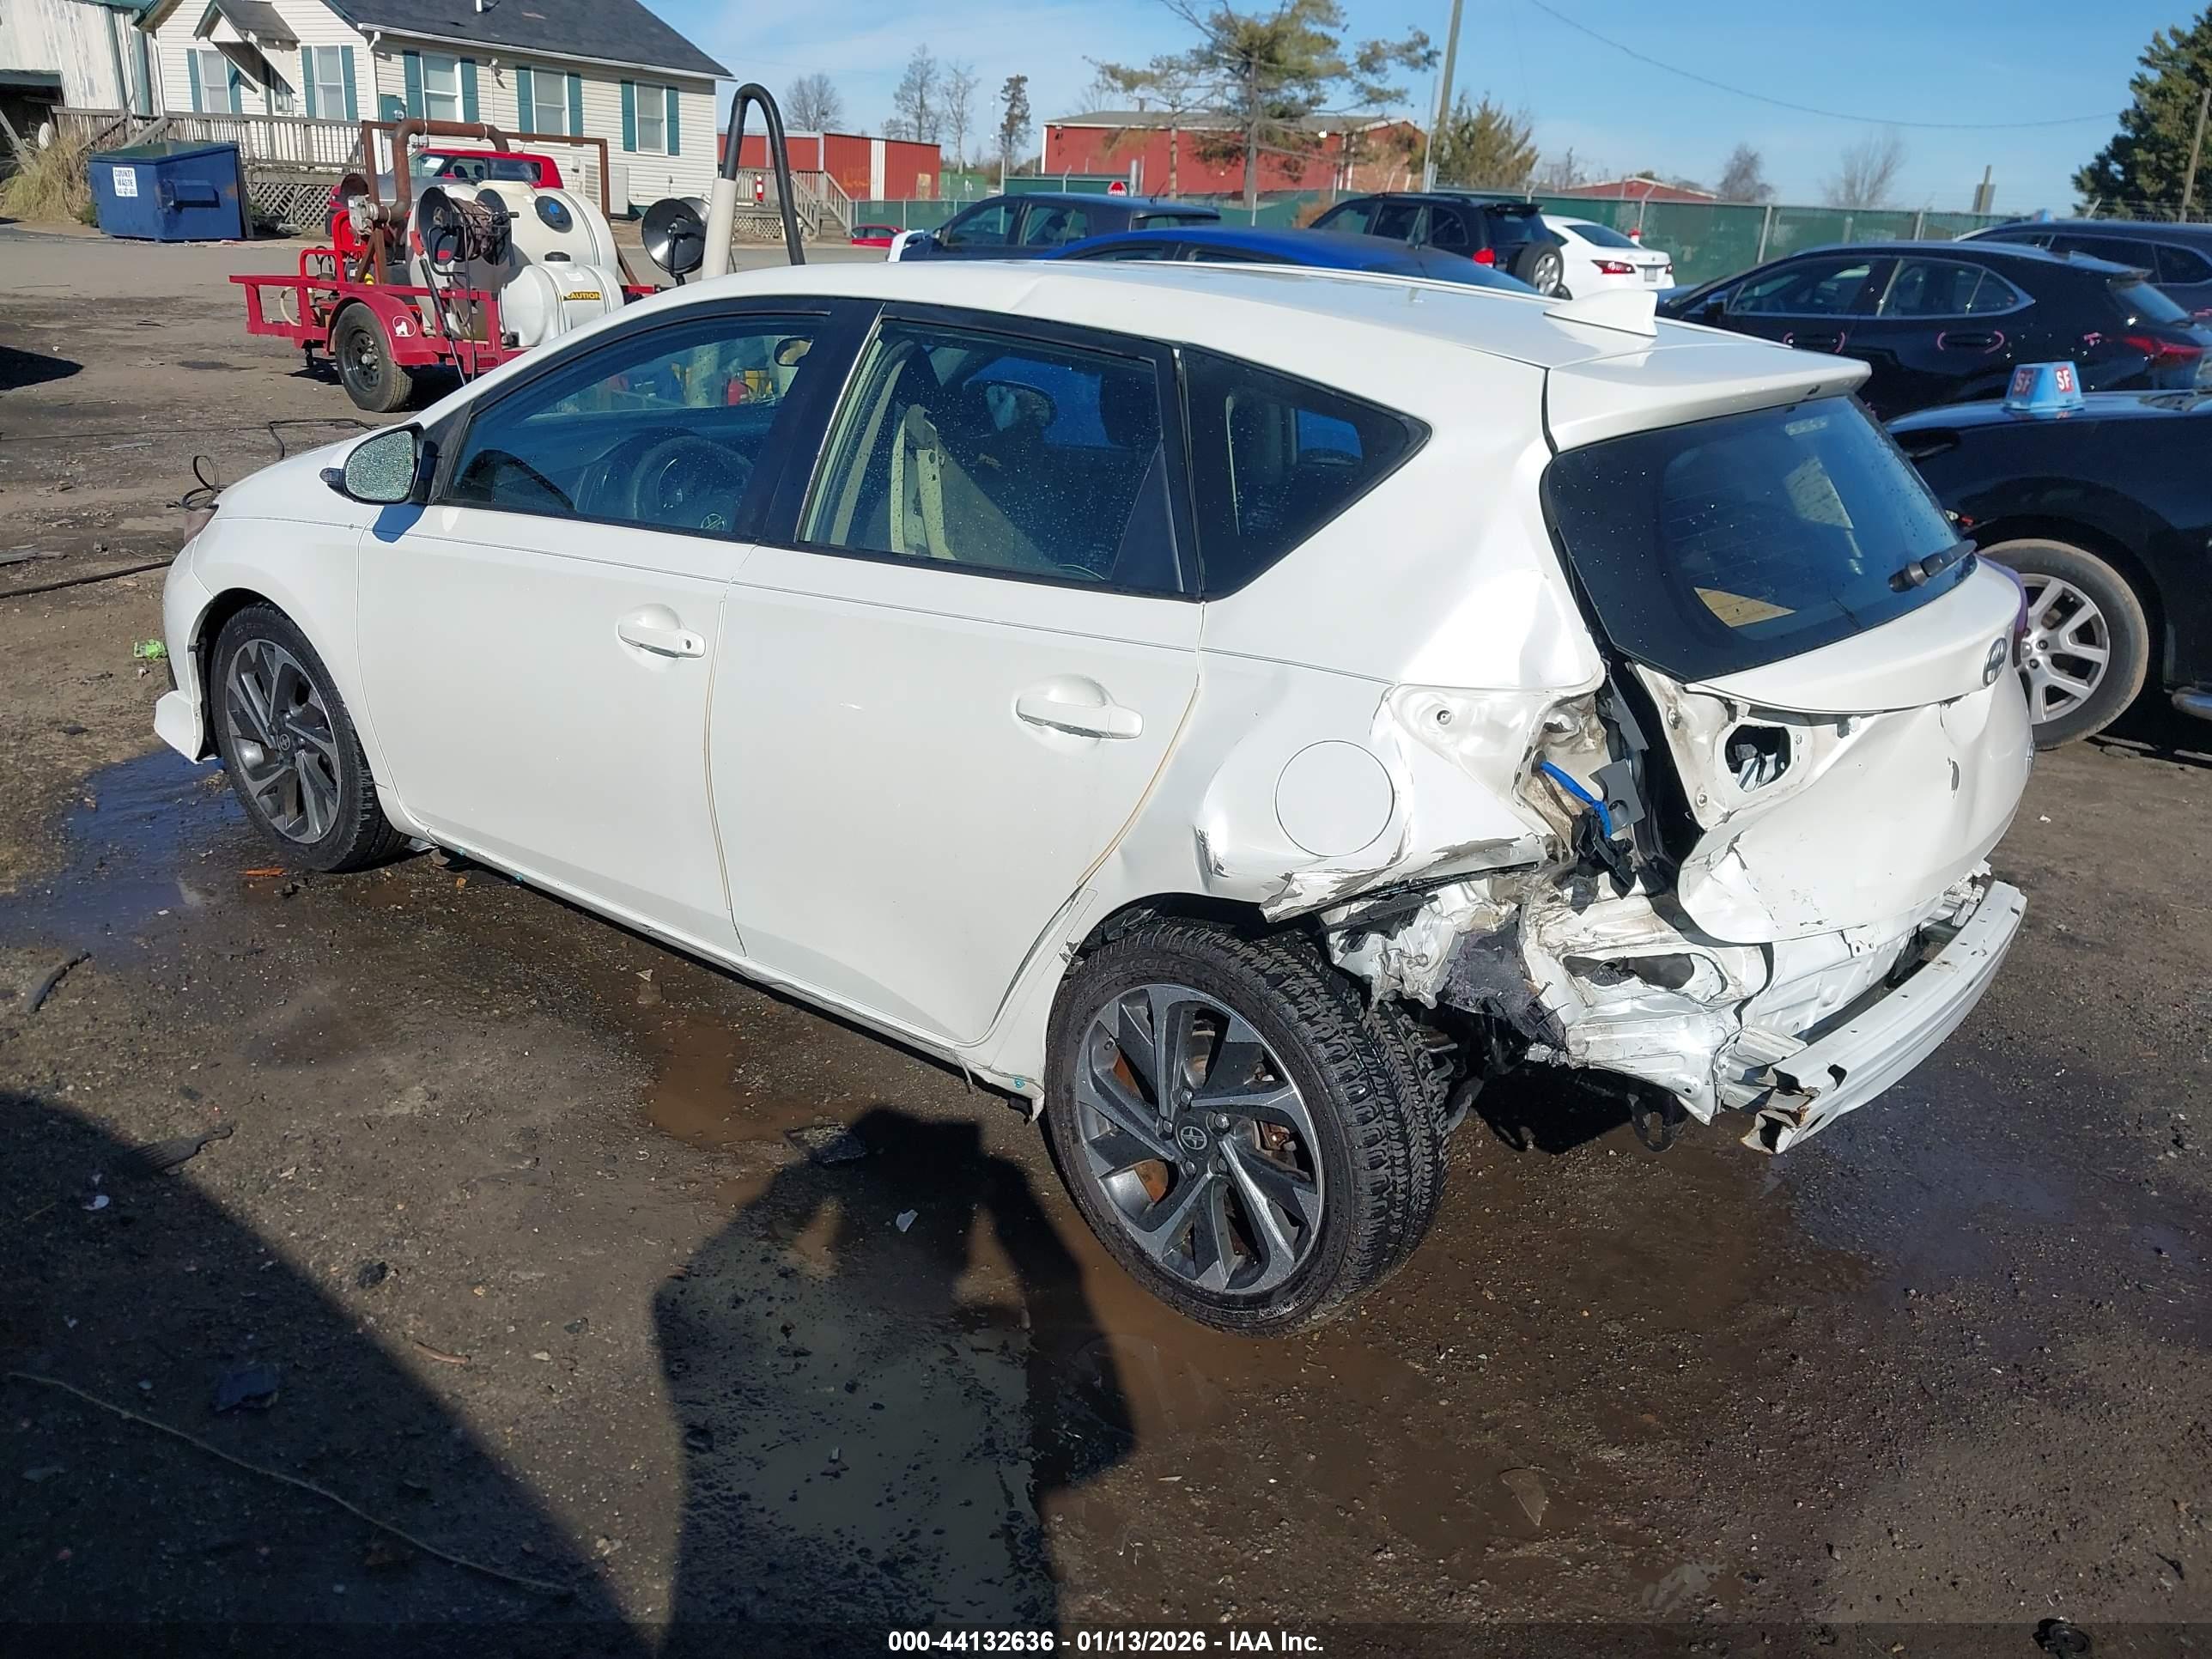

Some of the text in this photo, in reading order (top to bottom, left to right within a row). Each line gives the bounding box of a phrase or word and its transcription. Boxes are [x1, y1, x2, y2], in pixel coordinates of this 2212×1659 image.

[114, 169, 133, 178] COUNTY
[116, 178, 134, 186] WASTE
[2014, 373, 2032, 392] SF
[2056, 369, 2070, 391] SF
